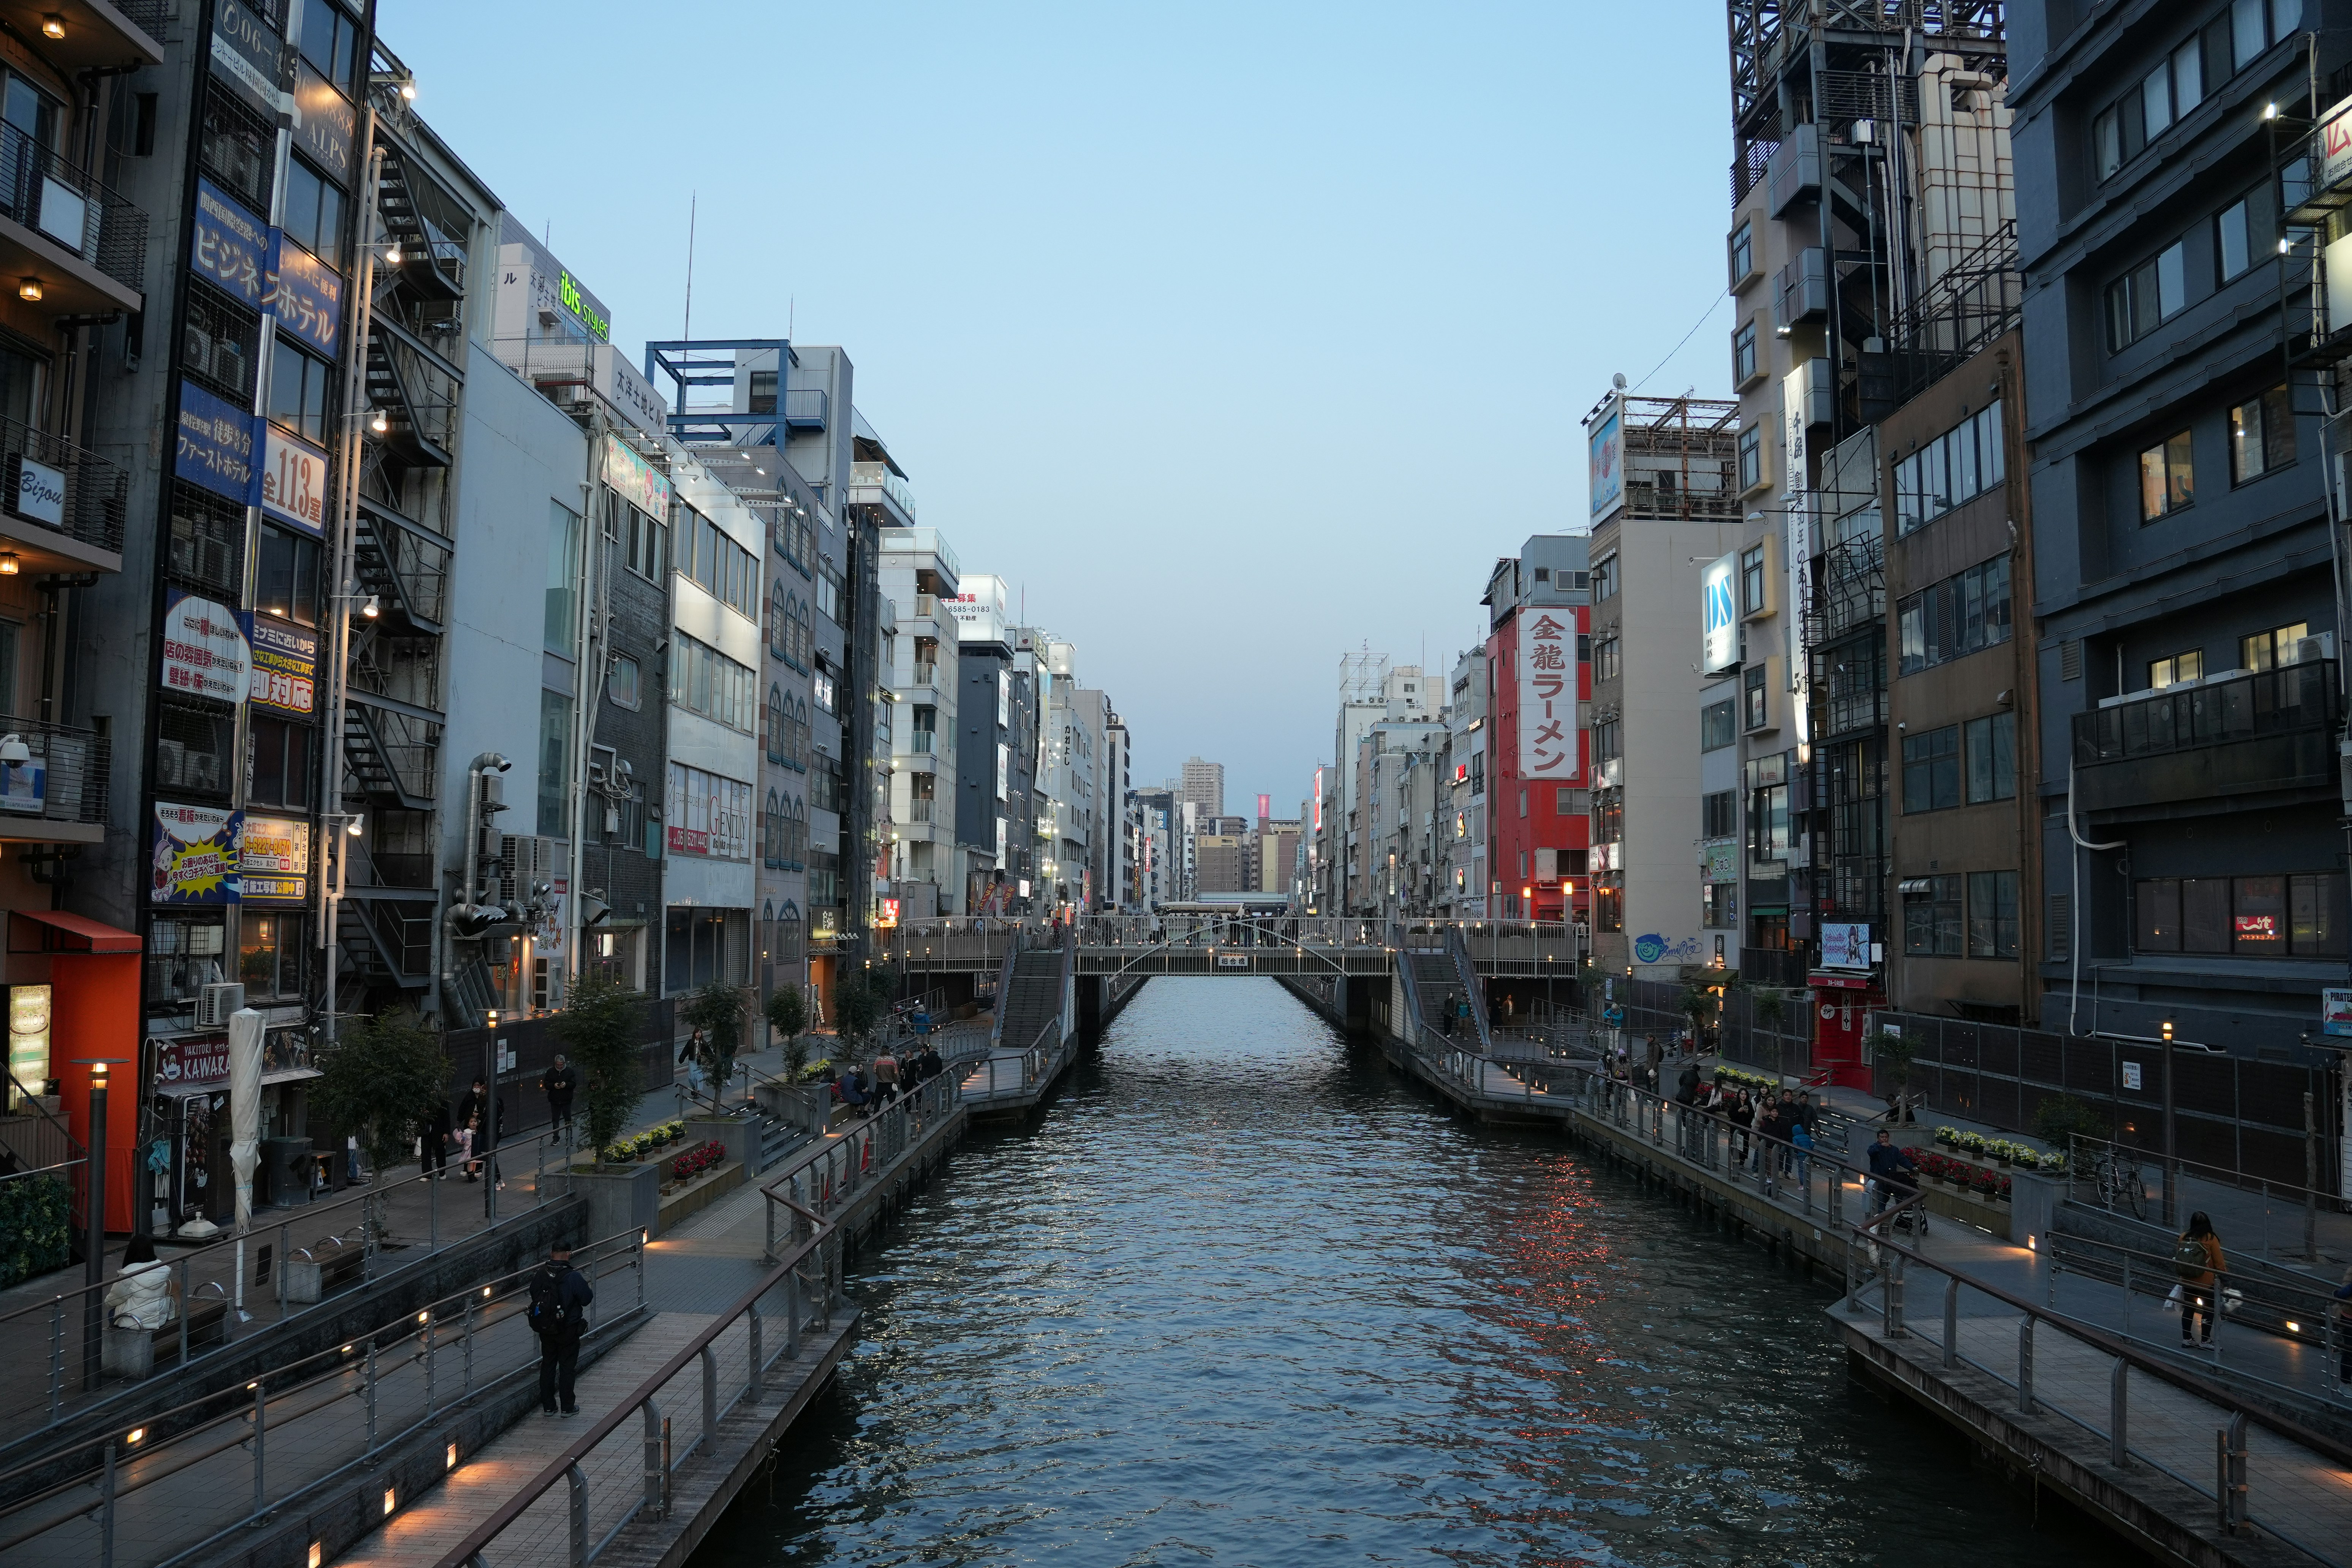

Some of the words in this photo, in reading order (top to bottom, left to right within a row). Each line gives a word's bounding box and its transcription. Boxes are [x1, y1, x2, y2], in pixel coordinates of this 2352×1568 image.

[307, 121, 348, 168] ALPS
[200, 191, 268, 251] 関西国際空港への
[197, 226, 334, 343] ビジネスホテル
[560, 270, 580, 315] ibis
[617, 368, 661, 428] 太洋土地ビル
[179, 434, 251, 484] ファーストホテル
[21, 471, 62, 505] Bijou
[263, 448, 321, 524] 全113室
[1706, 574, 1732, 634] DS
[254, 625, 315, 655] ミナミに近いから
[251, 668, 314, 712] 即対応
[1529, 615, 1566, 772] 金龍ラーメン
[181, 854, 220, 869] お困りのあなた
[249, 881, 295, 895] 施工写真公開中
[12, 1012, 46, 1028] biotop
[184, 1043, 212, 1057] YAKITORI
